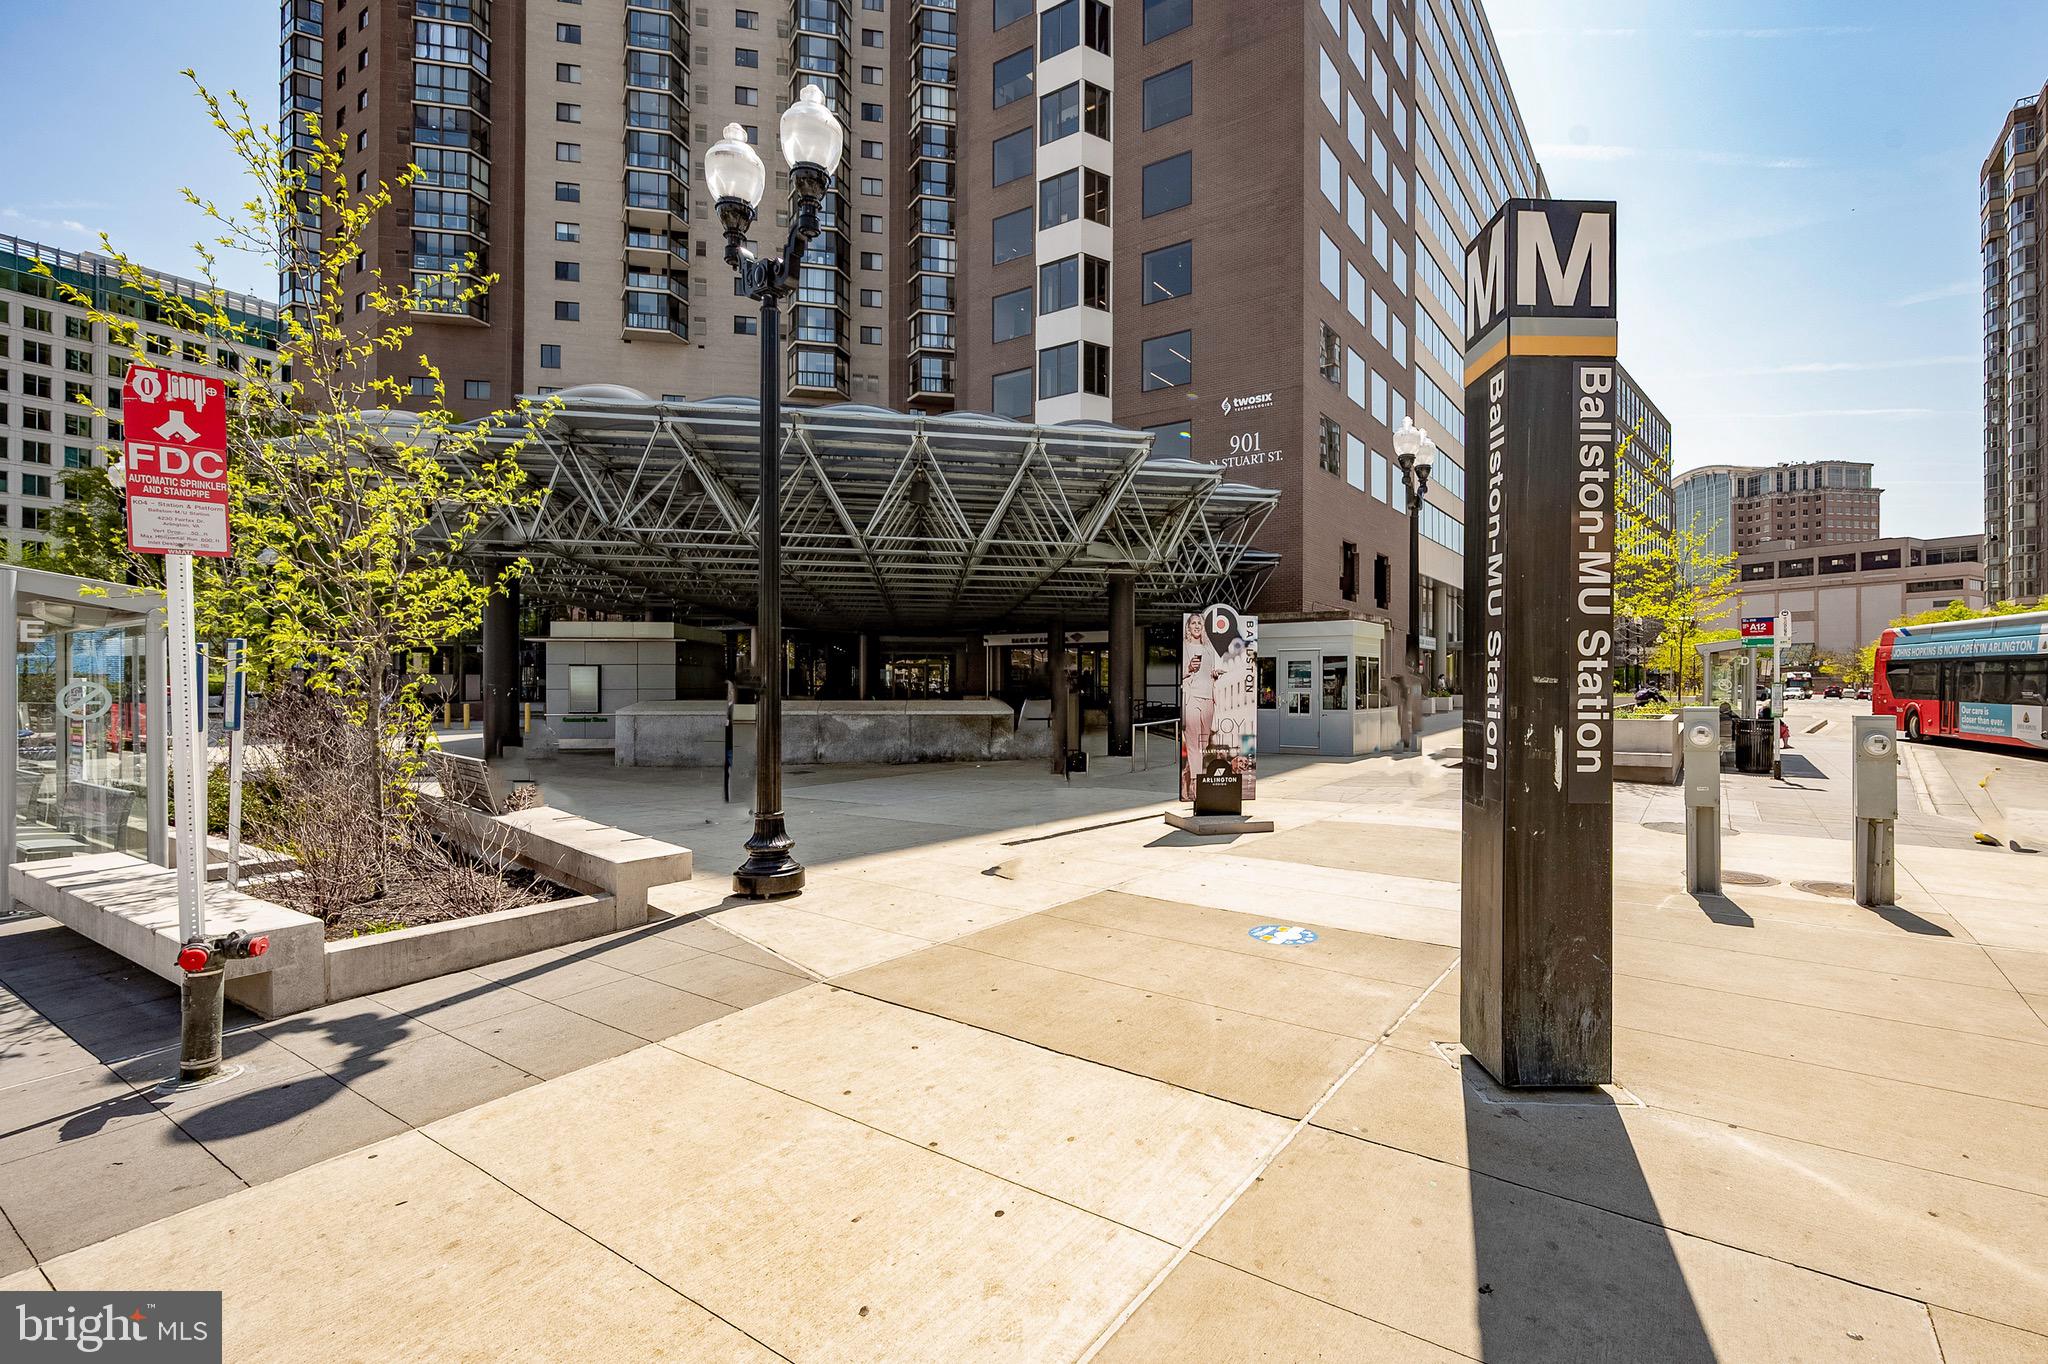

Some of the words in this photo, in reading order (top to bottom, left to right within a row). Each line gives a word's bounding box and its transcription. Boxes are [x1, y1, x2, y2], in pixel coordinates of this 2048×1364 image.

[1516, 210, 1610, 307] M
[1467, 216, 1504, 341] M
[1230, 432, 1260, 454] 901
[128, 442, 223, 479] FDC
[1221, 452, 1265, 468] STUART
[1268, 450, 1283, 462] ST.
[129, 473, 179, 487] AUTOMATIC
[180, 478, 226, 491] SPRINKLER
[143, 486, 162, 494] AND
[164, 487, 210, 498] STANDPIPE
[1488, 370, 1504, 616] Ballston-MU
[1578, 367, 1612, 614] Ballston-MU
[20, 620, 46, 642] E
[1894, 647, 1912, 657] JOHNS
[1912, 646, 1936, 656] HOPKINS
[1937, 646, 1944, 656] IS
[1944, 644, 1960, 656] NOW
[1960, 643, 1978, 654] OPEN
[1980, 643, 1987, 652] IN
[1988, 640, 2035, 652] ARLINGTON.
[1486, 630, 1502, 770] Station
[1576, 630, 1611, 773] Station
[1961, 706, 1970, 714] Our
[1984, 706, 1989, 715] is
[1214, 718, 1245, 733] JOY
[1962, 715, 1977, 723] closer
[1978, 716, 1989, 724] than
